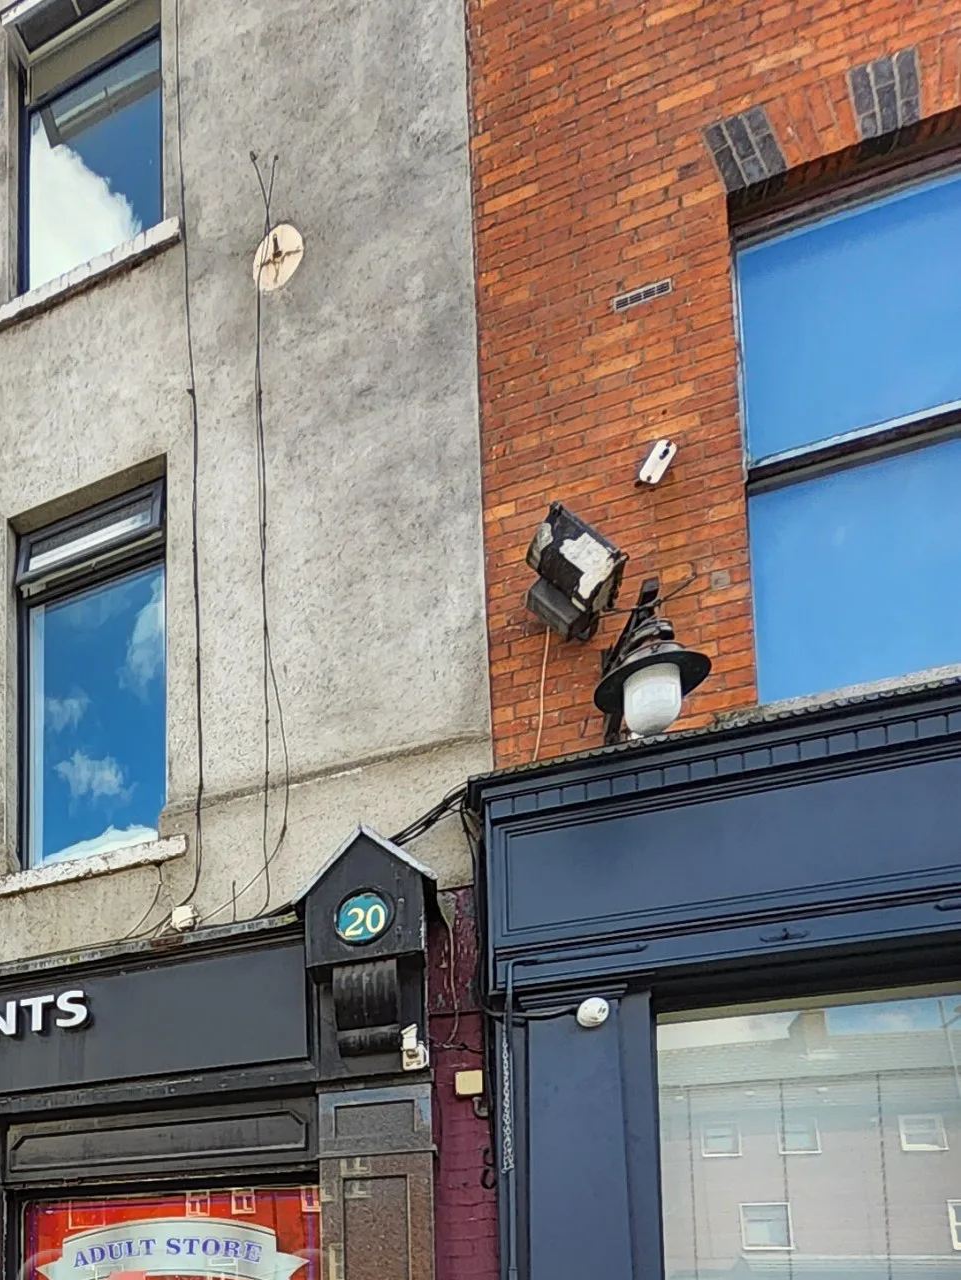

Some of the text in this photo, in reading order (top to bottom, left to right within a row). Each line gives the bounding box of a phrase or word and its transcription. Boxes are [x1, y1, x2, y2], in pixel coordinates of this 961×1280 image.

[344, 904, 386, 937] 20
[73, 1237, 262, 1269] ADULT STORE
